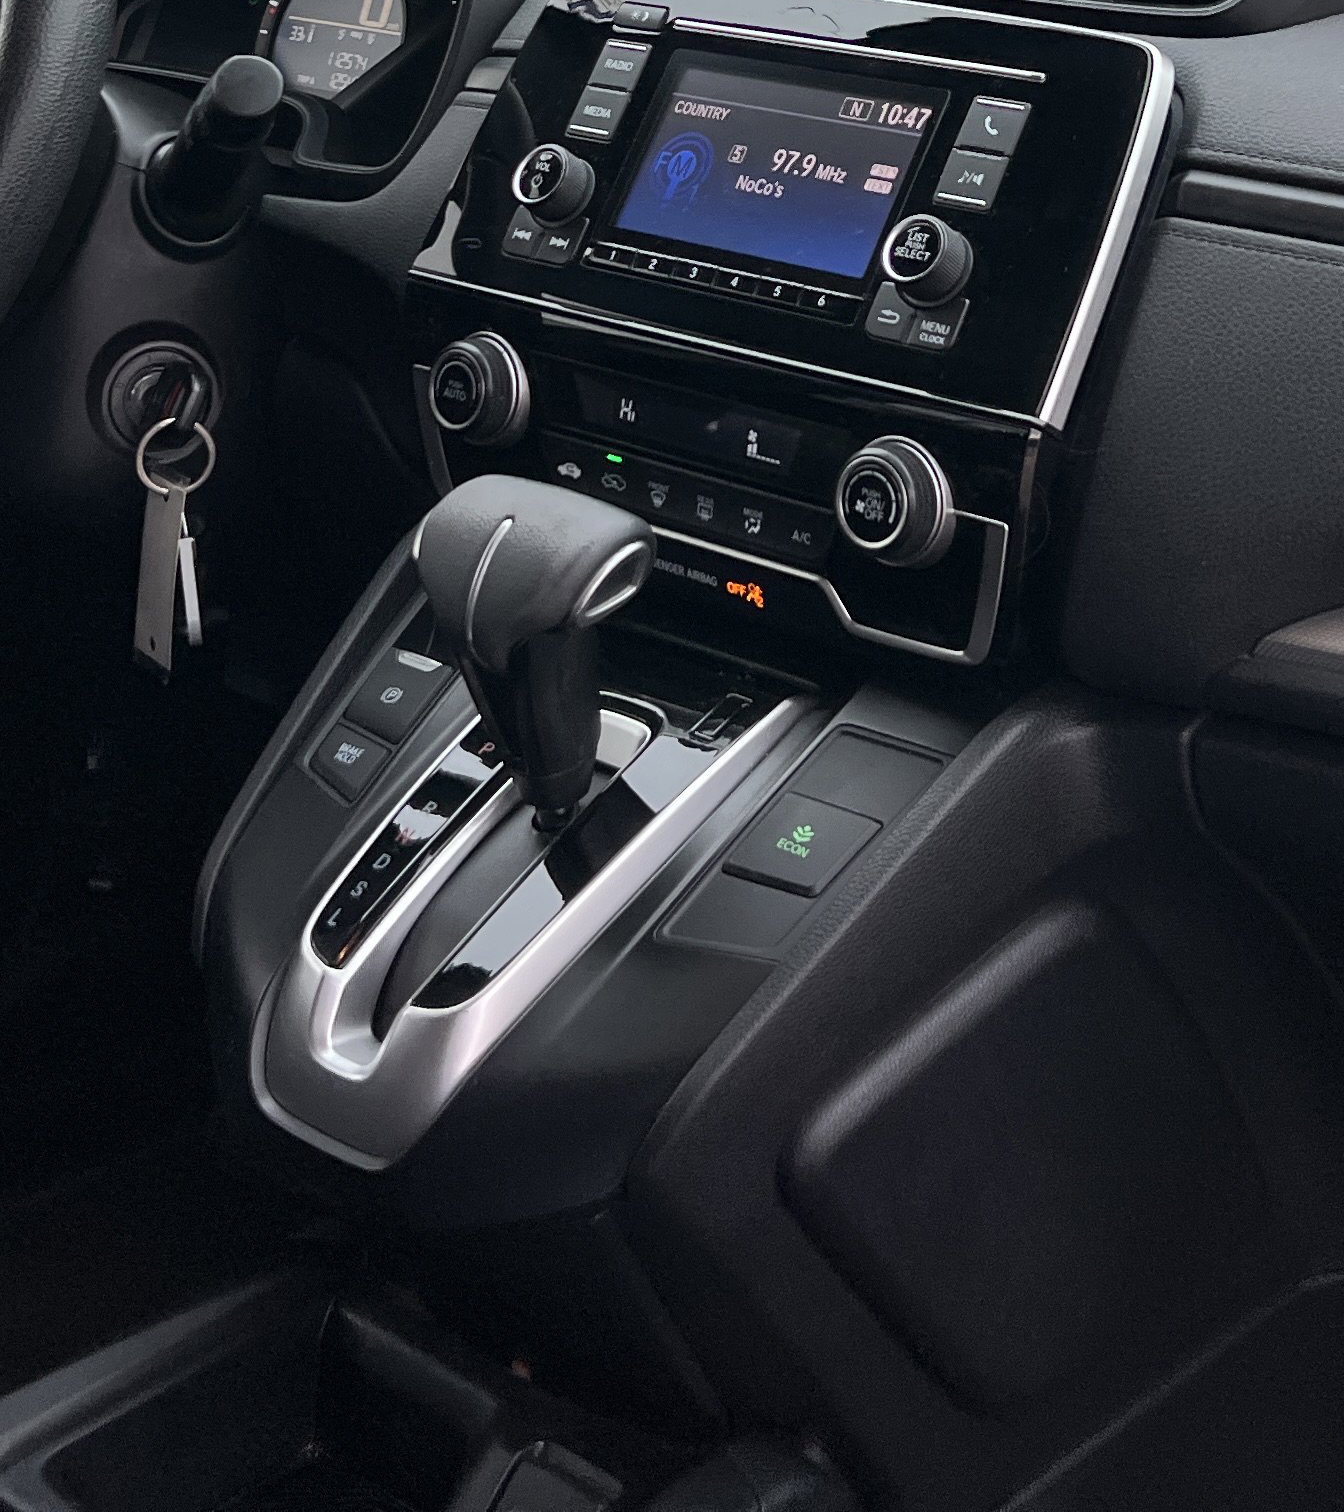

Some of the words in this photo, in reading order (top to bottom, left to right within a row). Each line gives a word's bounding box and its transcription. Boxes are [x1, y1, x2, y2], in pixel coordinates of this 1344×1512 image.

[604, 58, 634, 72] RADIO
[583, 104, 612, 119] MEDIA
[674, 99, 732, 121] COUNTRY
[878, 101, 933, 130] 10:47
[536, 161, 551, 173] VOL
[771, 148, 818, 178] 97.9
[814, 163, 848, 185] MHz
[735, 174, 785, 199] NoCo's
[907, 231, 931, 243] LIST
[609, 250, 616, 261] 1
[894, 246, 931, 262] SELECT
[648, 258, 658, 270] 2
[689, 267, 699, 279] 3
[730, 276, 740, 288] 4
[772, 285, 783, 297] 5
[817, 295, 827, 307] 6
[920, 319, 951, 335] MENU
[919, 332, 946, 345] CLOCK
[442, 387, 467, 402] AUTO
[864, 509, 885, 522] OFF
[791, 529, 812, 546] A/C
[654, 558, 685, 577] ENGER
[686, 567, 718, 587] AIRBAG
[726, 581, 747, 597] OFF
[477, 741, 496, 754] P
[422, 800, 438, 814] R
[776, 837, 811, 859] ECON
[372, 852, 392, 870] D
[350, 880, 368, 898] S
[327, 907, 343, 927] L
